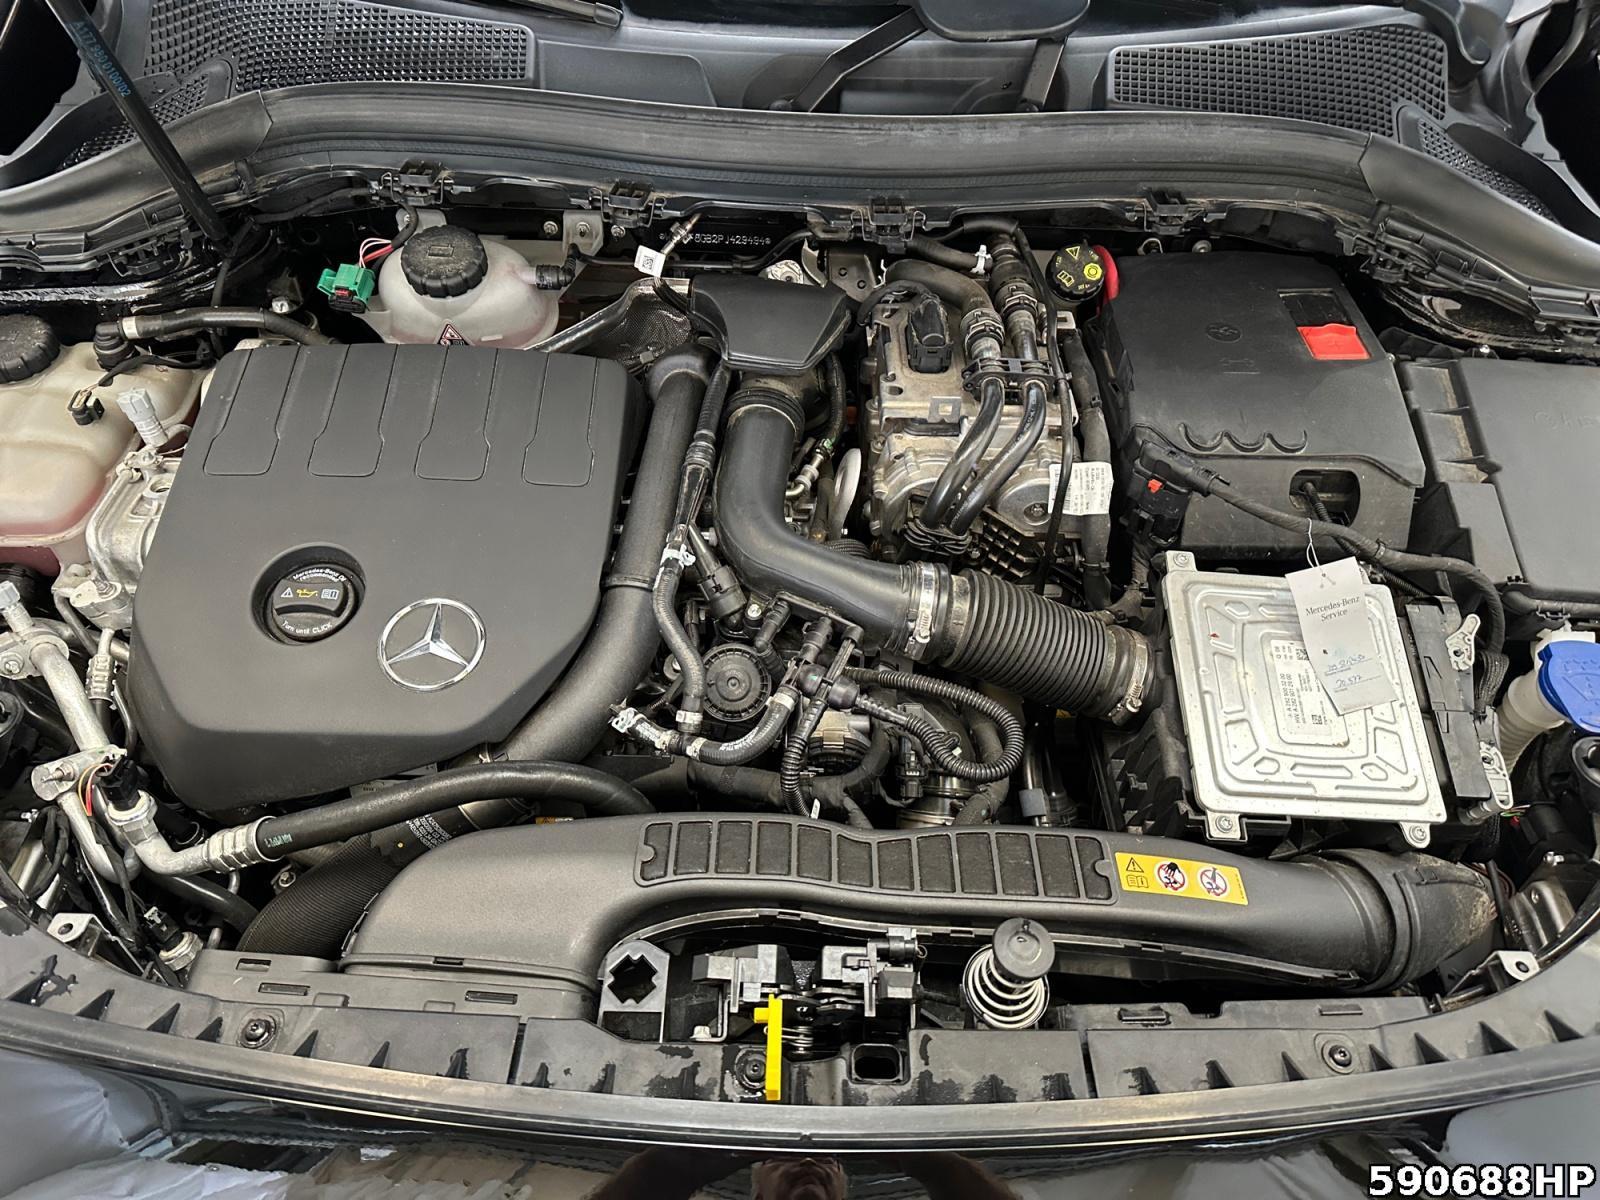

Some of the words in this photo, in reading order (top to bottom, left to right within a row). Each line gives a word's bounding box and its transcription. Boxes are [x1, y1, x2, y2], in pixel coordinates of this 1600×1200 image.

[1305, 596, 1360, 616] Mercedes-Benz
[1320, 609, 1348, 622] Service
[282, 620, 294, 632] Turn
[295, 627, 310, 635] until
[312, 622, 333, 634] CLICK
